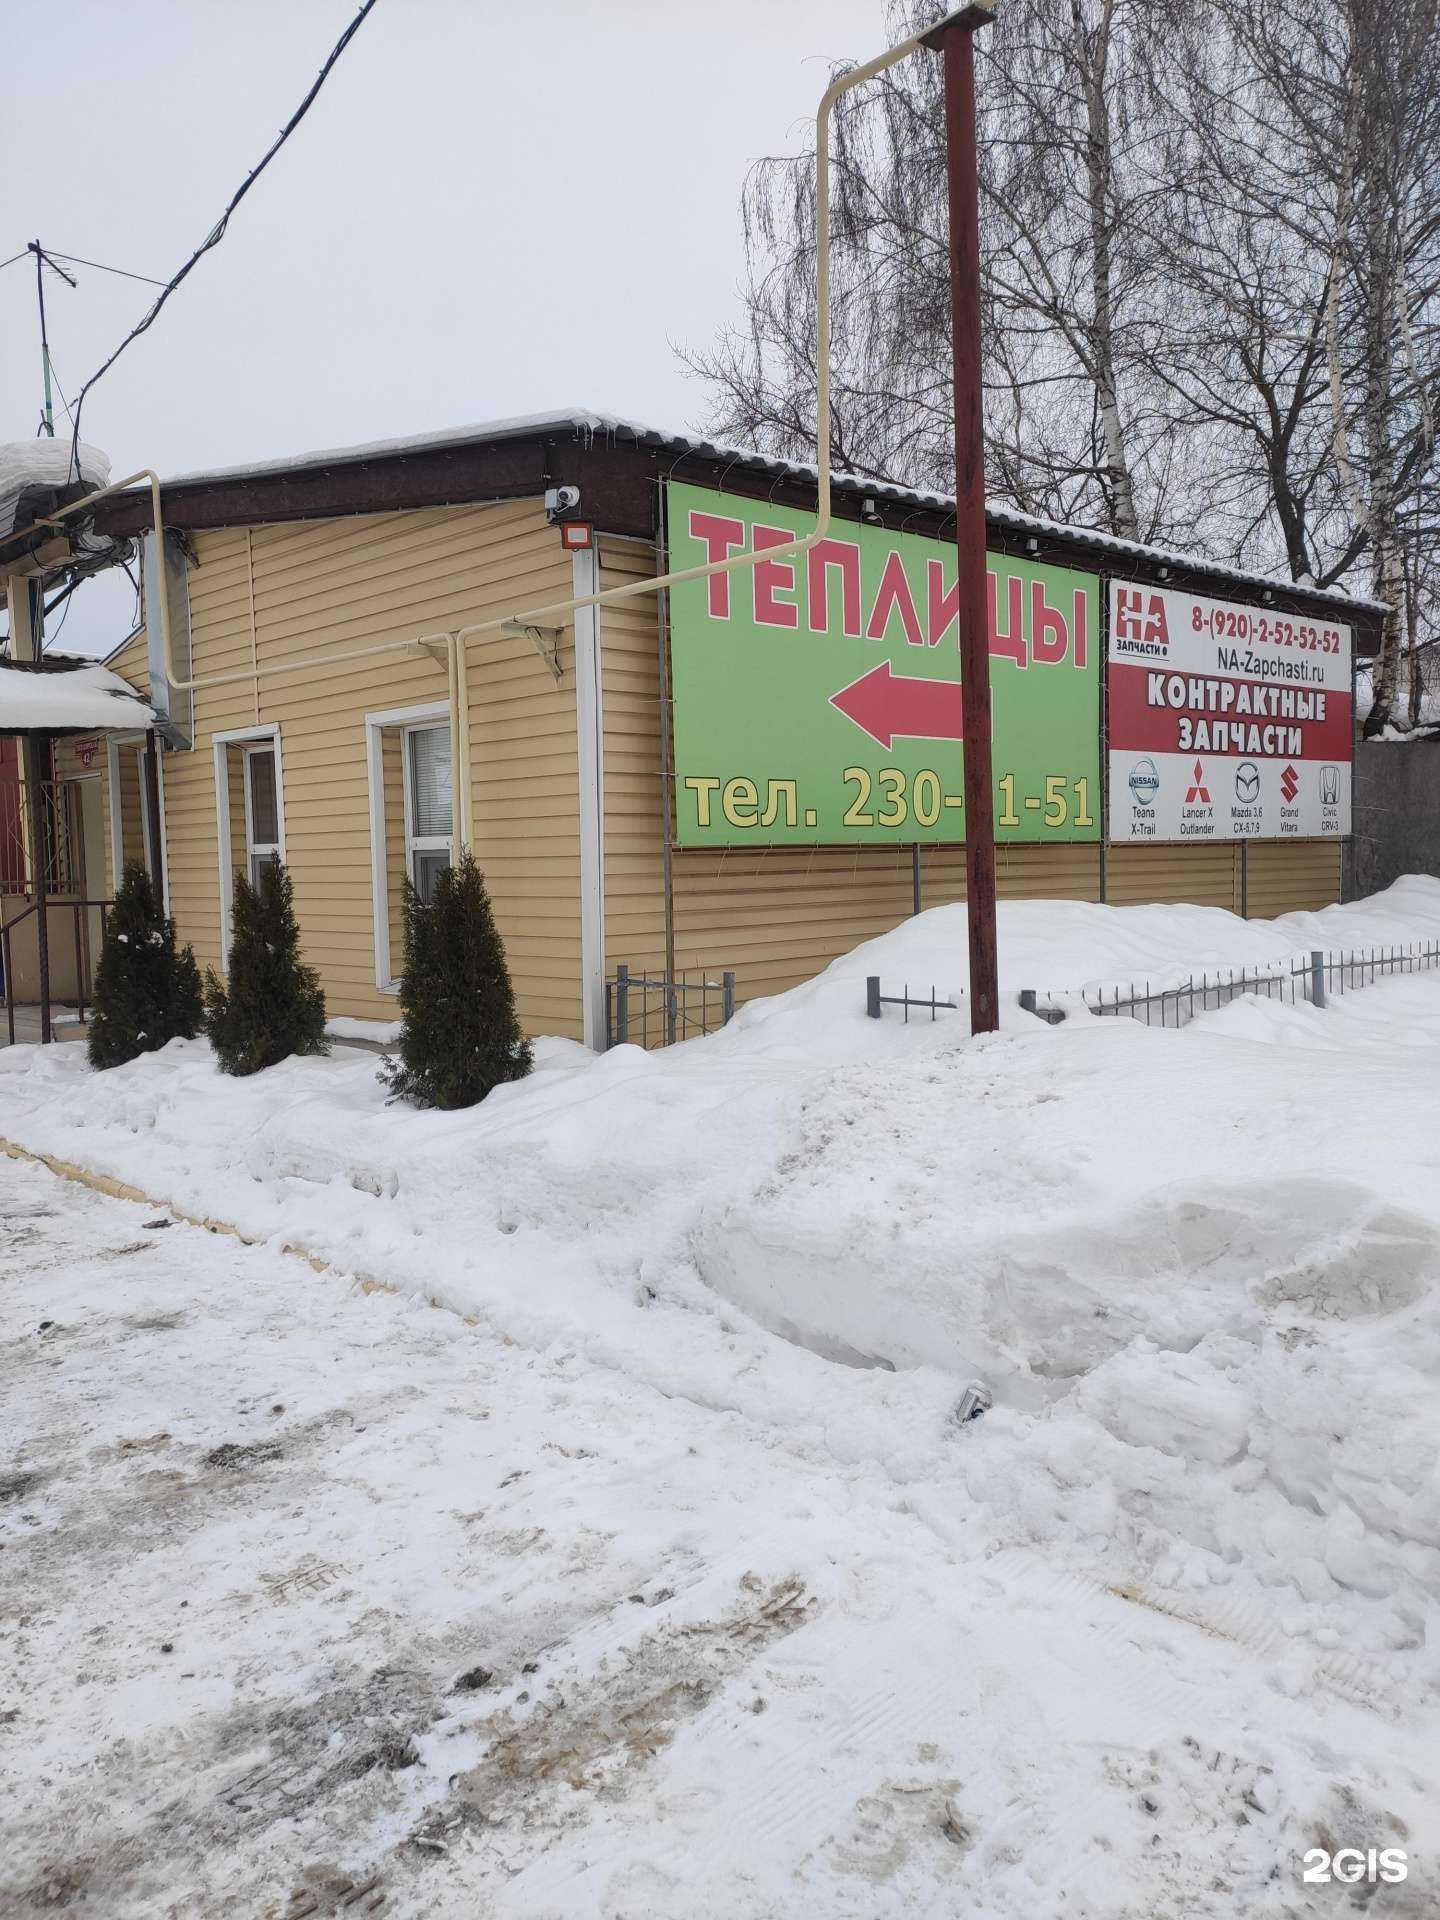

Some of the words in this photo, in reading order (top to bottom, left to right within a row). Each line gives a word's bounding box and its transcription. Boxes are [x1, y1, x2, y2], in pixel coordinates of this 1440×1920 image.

[1192, 606, 1340, 654] 8-(920)-2-52-52-52
[1116, 638, 1161, 655] ЗАПЧАСТИ
[1218, 646, 1325, 682] NA-Zapchasti.ru
[1148, 672, 1326, 722] КОНТРАКТНЫЕ
[1177, 716, 1302, 756] ЗАПЧАСТИ
[1131, 776, 1157, 785] NISSAN
[685, 776, 817, 827] тел.
[842, 766, 1094, 828] 230-1-51
[1132, 806, 1155, 818] Teana
[1182, 806, 1207, 818] Lancer
[1207, 807, 1213, 818] X
[1231, 806, 1252, 818] Mazda
[1280, 806, 1299, 818] Grand
[1322, 806, 1338, 817] Civic
[1131, 823, 1156, 836] X-Trail
[1180, 823, 1215, 835] Outlander
[1280, 821, 1298, 833] Vitara
